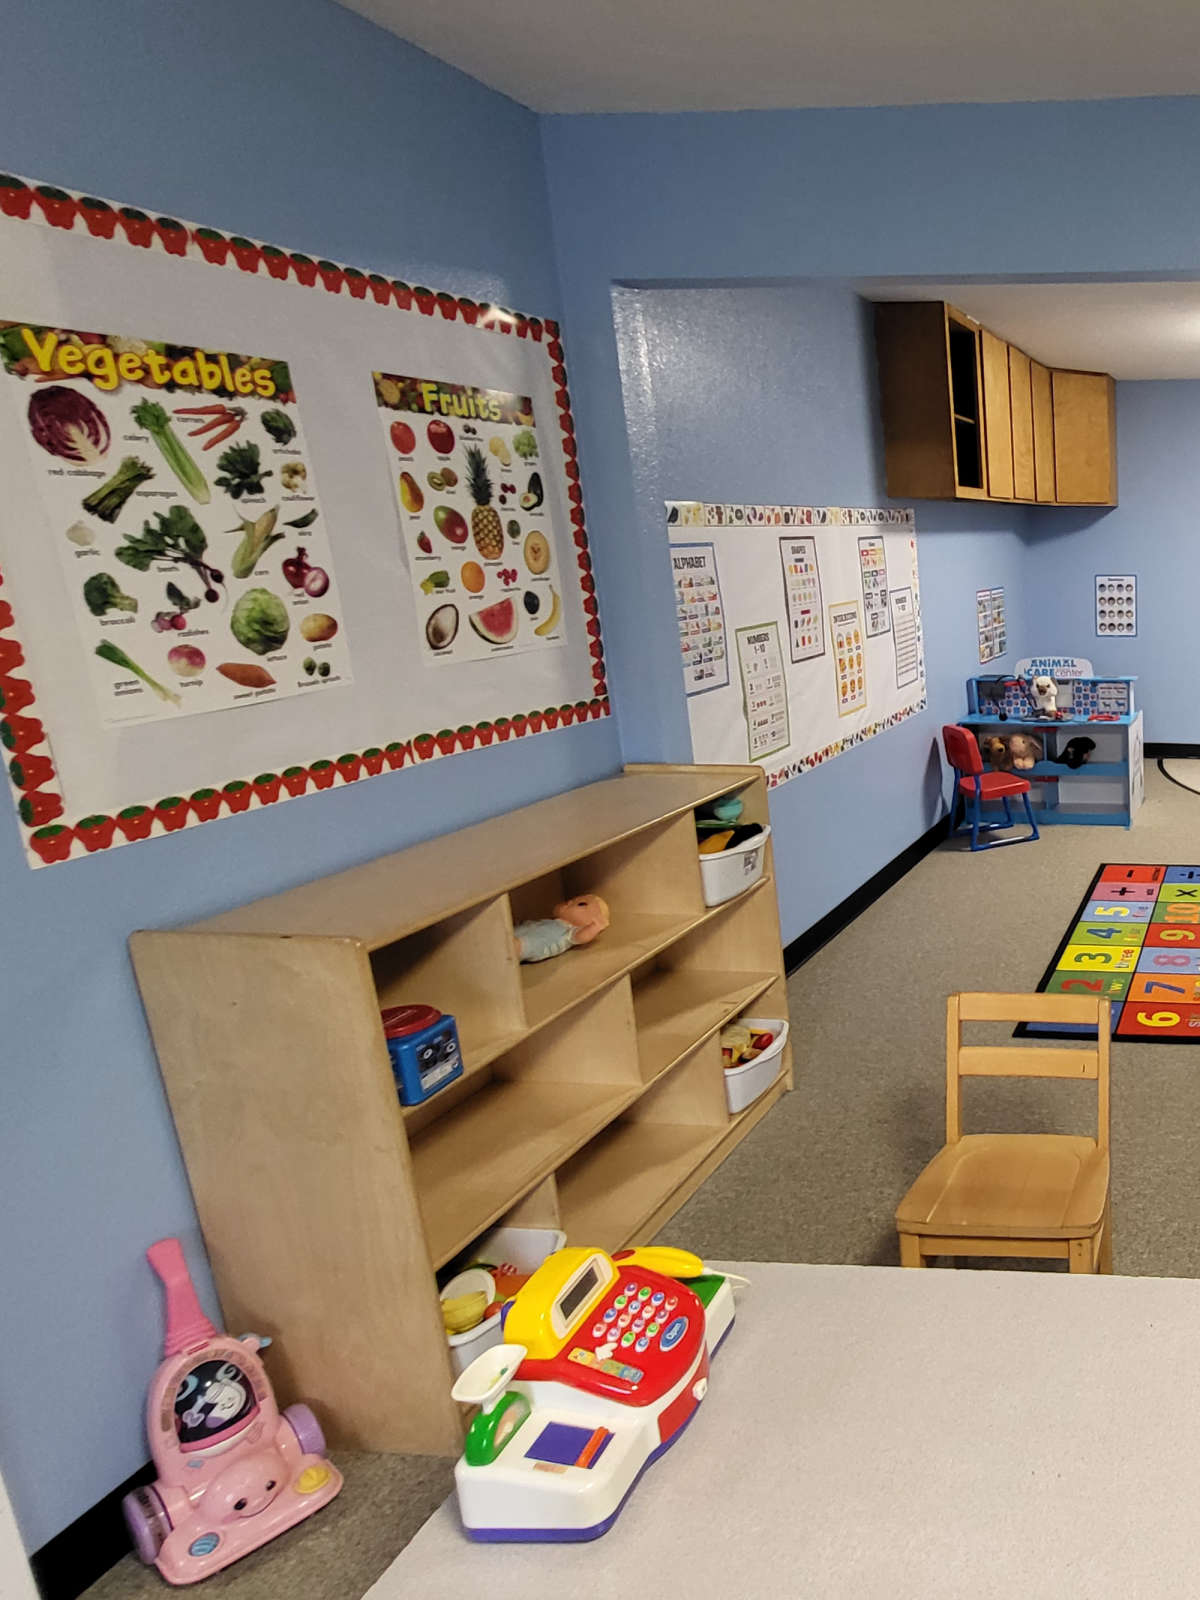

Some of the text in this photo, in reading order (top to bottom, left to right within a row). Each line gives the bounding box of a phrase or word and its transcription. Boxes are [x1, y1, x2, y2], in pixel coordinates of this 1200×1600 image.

[21, 328, 276, 397] Vegetables
[420, 382, 502, 421] Fruits
[673, 556, 706, 569] ALPHABET
[1031, 659, 1077, 668] ANIMAL
[1027, 668, 1083, 677] CARE center
[1094, 906, 1130, 918] 5
[1164, 903, 1200, 923] 10
[1086, 927, 1122, 939] 4
[1160, 929, 1196, 941] 9
[1074, 952, 1113, 964] 3
[1153, 953, 1192, 967] 8
[1061, 979, 1105, 992] 2
[1144, 981, 1186, 994] 7
[1136, 1010, 1181, 1027] 6
